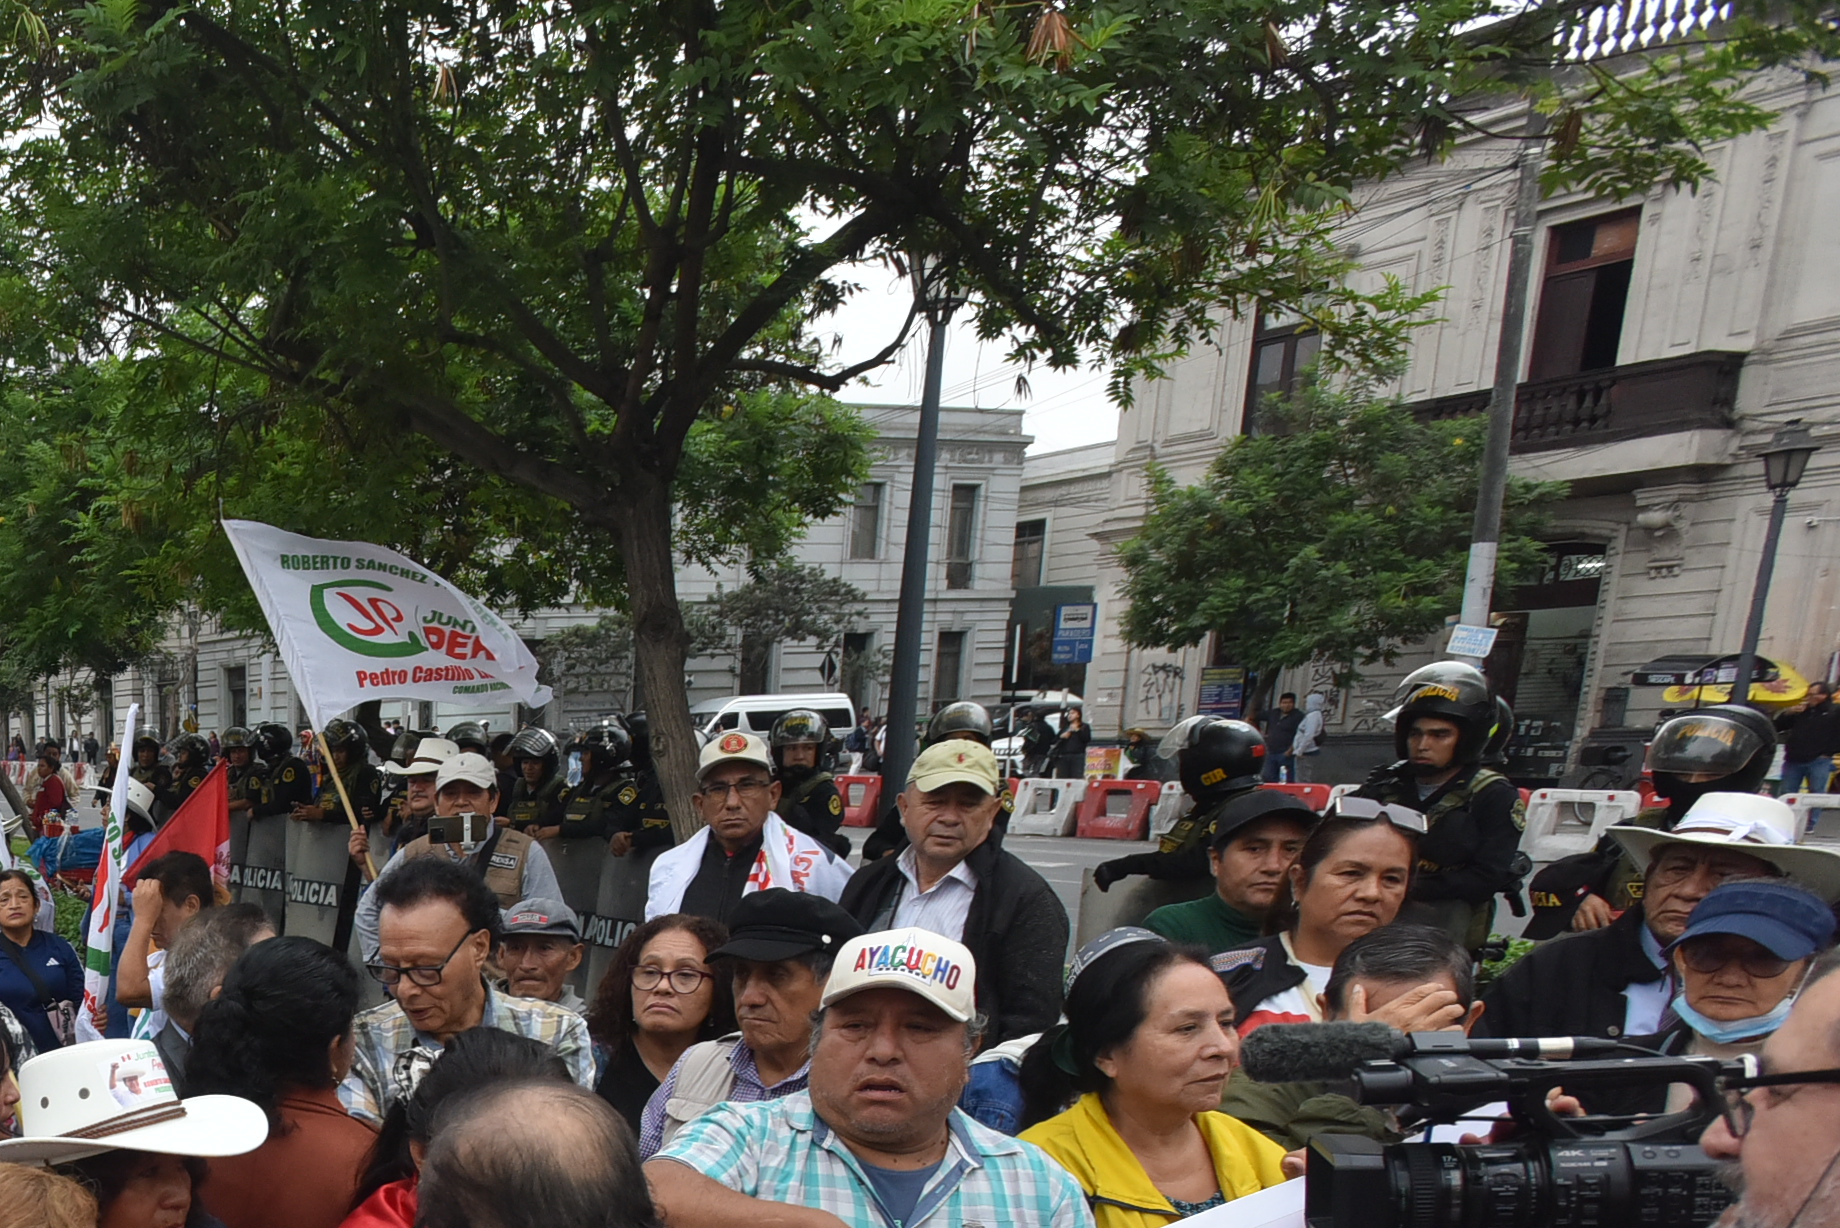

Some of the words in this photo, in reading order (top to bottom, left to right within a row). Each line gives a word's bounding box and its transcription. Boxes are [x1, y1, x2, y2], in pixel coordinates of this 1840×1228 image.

[280, 553, 351, 571] ROBERTO
[355, 557, 428, 585] SÁNCHEZ
[356, 667, 409, 688] Pedro
[411, 665, 473, 684] Castillo
[852, 944, 962, 990] AYACUCHO
